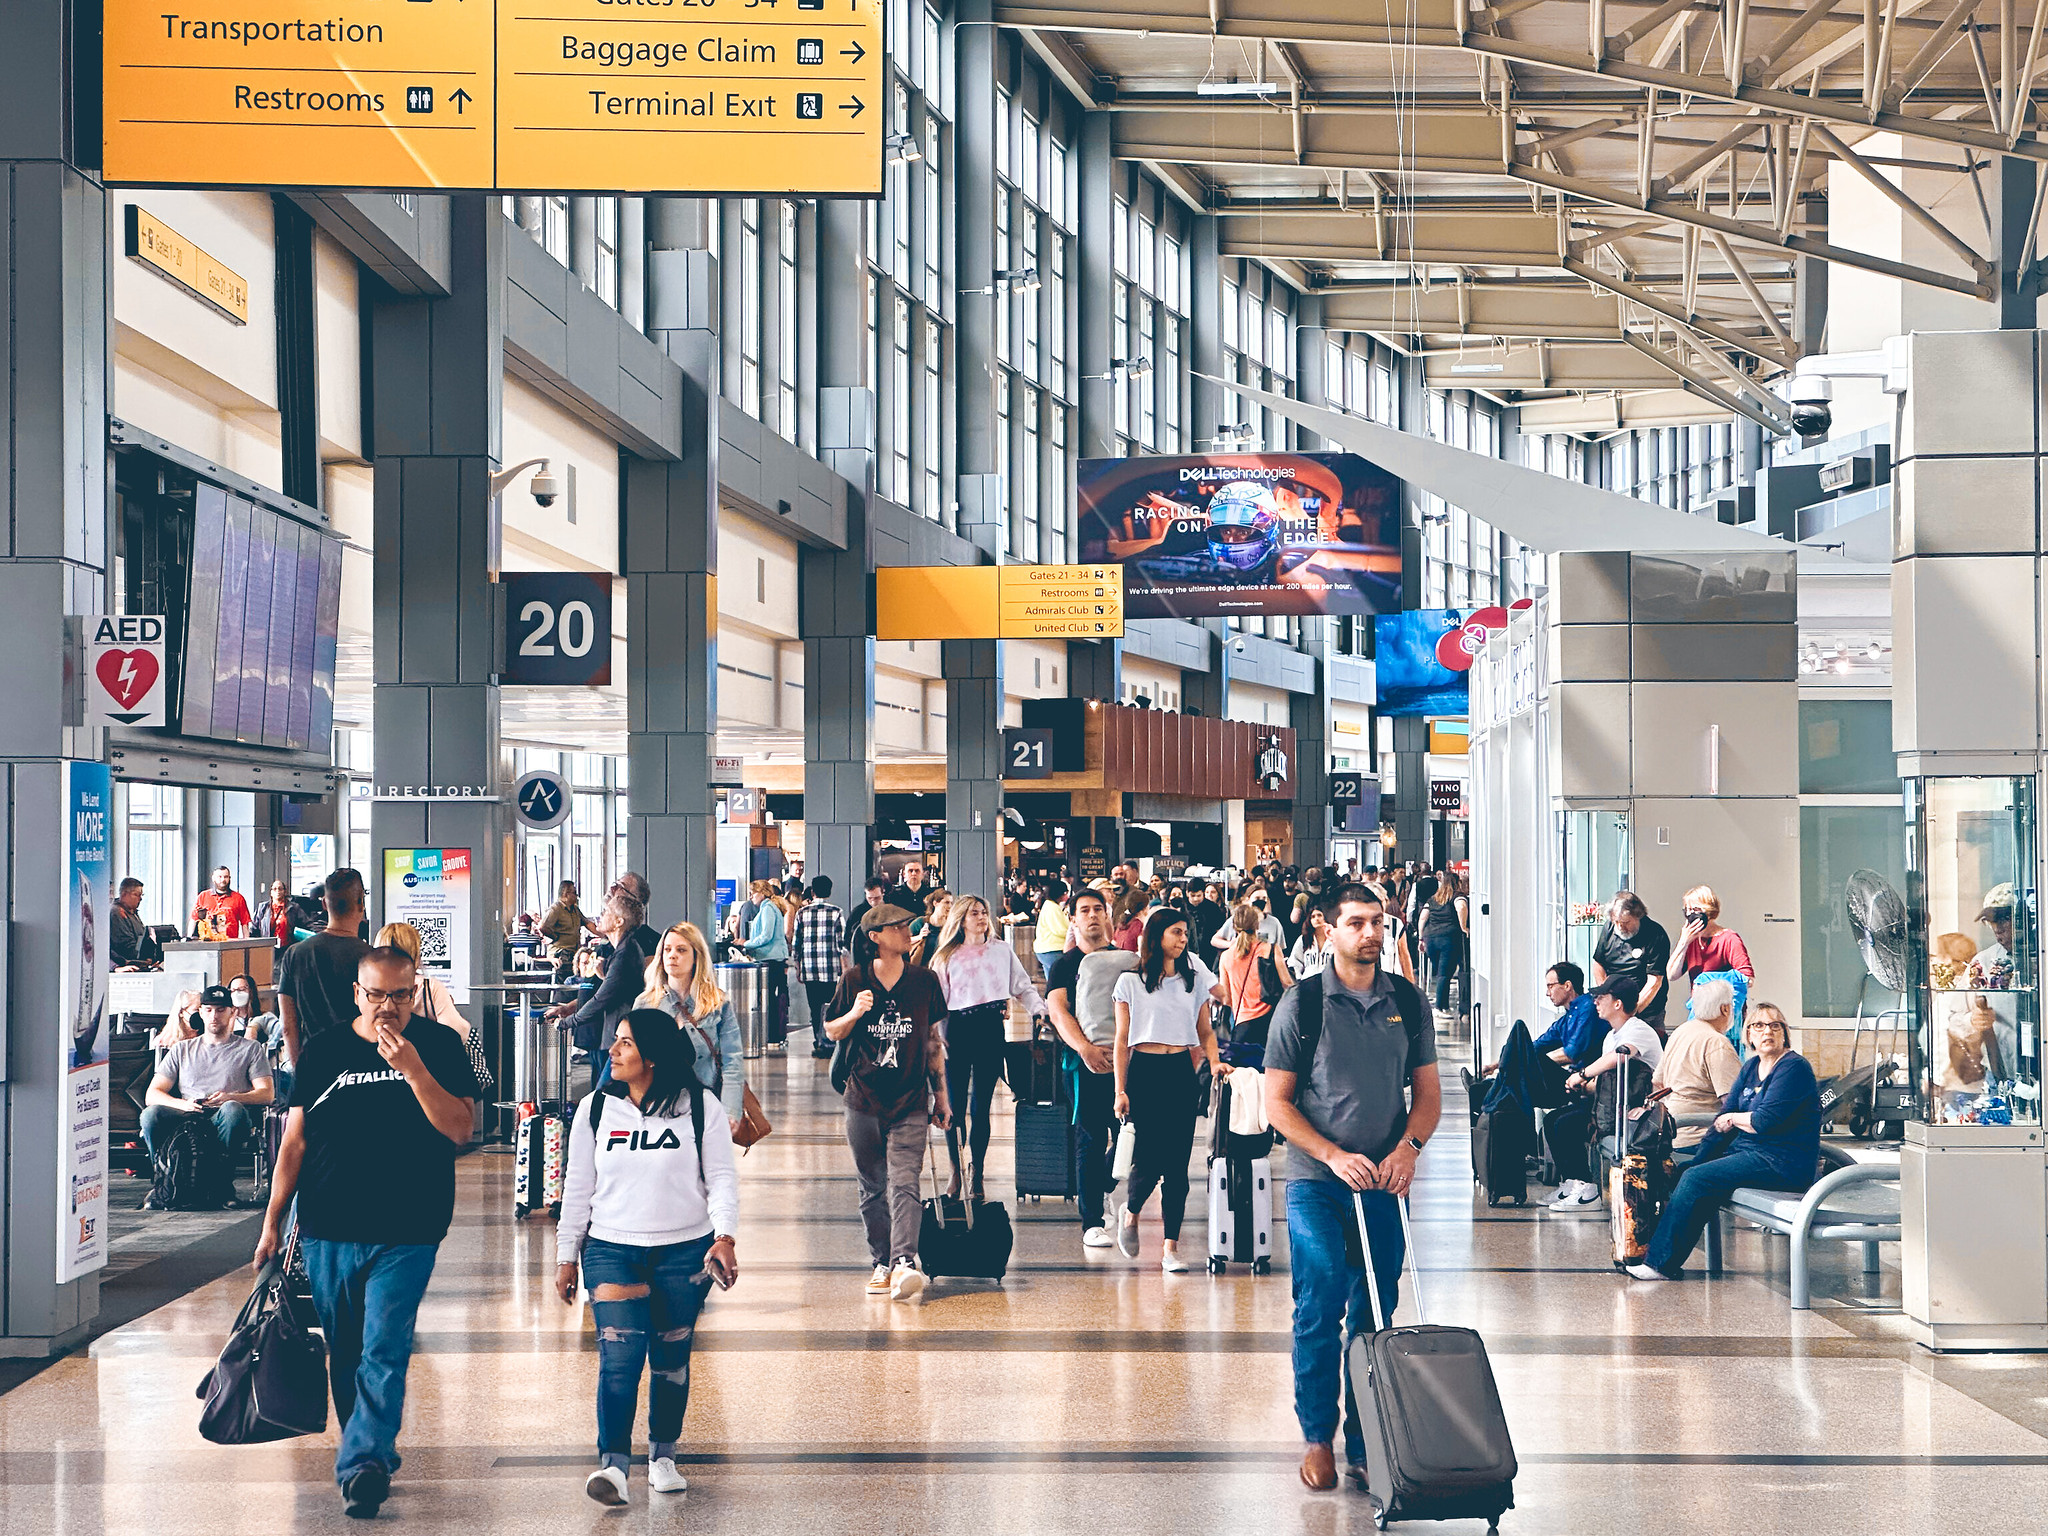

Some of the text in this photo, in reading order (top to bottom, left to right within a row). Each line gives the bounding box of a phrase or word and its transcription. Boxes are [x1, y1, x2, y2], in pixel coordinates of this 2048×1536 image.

[160, 14, 383, 46] Transportation
[561, 35, 776, 68] Baggage Claim
[234, 85, 385, 112] Restrooms
[588, 91, 777, 117] Terminal Exit
[1179, 466, 1296, 481] DELL Technologies
[1134, 505, 1201, 520] RACING
[1176, 520, 1201, 533] ON
[1284, 517, 1317, 530] THE
[1283, 531, 1336, 545] EDGE.
[1029, 571, 1056, 580] Gates
[1058, 571, 1068, 580] 21
[1077, 570, 1089, 579] 34
[1040, 588, 1090, 598] Restrooms
[1128, 587, 1149, 595] We're
[1150, 586, 1174, 595] driving
[1217, 584, 1235, 592] edge
[1301, 582, 1320, 590] miles
[1321, 583, 1333, 591] per
[1334, 582, 1353, 590] hour.
[1024, 605, 1089, 616] Admirals Club
[93, 617, 162, 642] AED
[518, 600, 595, 658] 20
[1034, 623, 1090, 633] United Club
[1012, 741, 1044, 767] 21
[715, 759, 740, 767] Wi-Fi
[359, 785, 488, 797] DIRECTORY
[1333, 780, 1357, 798] 22
[1432, 783, 1460, 792] VINO
[732, 792, 753, 810] 21
[1432, 797, 1460, 806] VOLO
[76, 811, 104, 842] MORE
[417, 855, 438, 870] SAVOR
[442, 855, 468, 872] GROOVE
[1155, 859, 1185, 868] SALT LICK
[403, 874, 453, 884] AUSTIN STYLE
[867, 1022, 913, 1034] NORMAN'S
[306, 1069, 407, 1113] METALLIC
[606, 1127, 681, 1152] FILA
